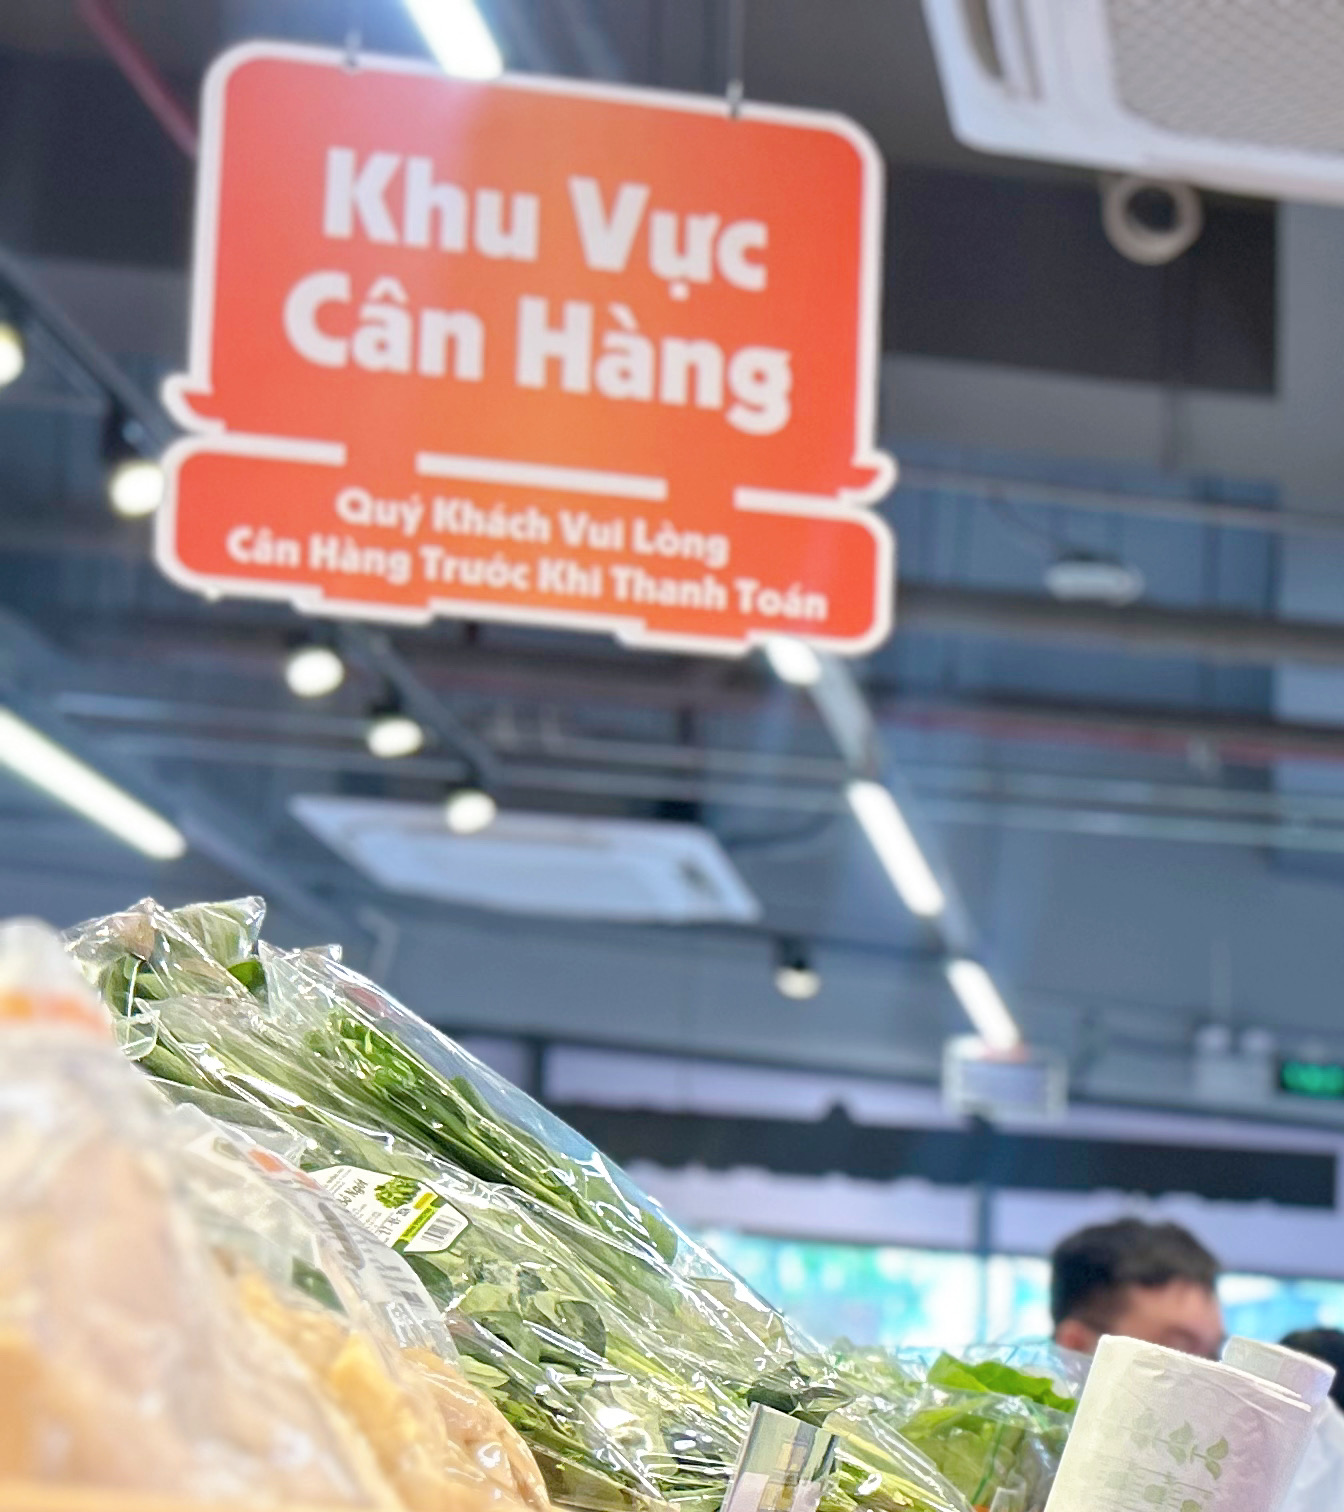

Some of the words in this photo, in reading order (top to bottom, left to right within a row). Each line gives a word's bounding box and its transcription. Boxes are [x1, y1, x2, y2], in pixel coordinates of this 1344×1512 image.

[323, 147, 539, 261] Khu
[569, 176, 769, 300] Vực
[284, 270, 484, 383] Cân
[516, 295, 793, 435] Hàng
[226, 524, 301, 568] Cân
[308, 533, 413, 586] Hàng
[537, 557, 603, 600] Khi
[610, 562, 728, 612] Thanh
[733, 576, 829, 622] Toán
[335, 486, 424, 537] Quý
[432, 495, 551, 543] Khách
[558, 509, 626, 551] Vui
[631, 517, 730, 570] Lòng
